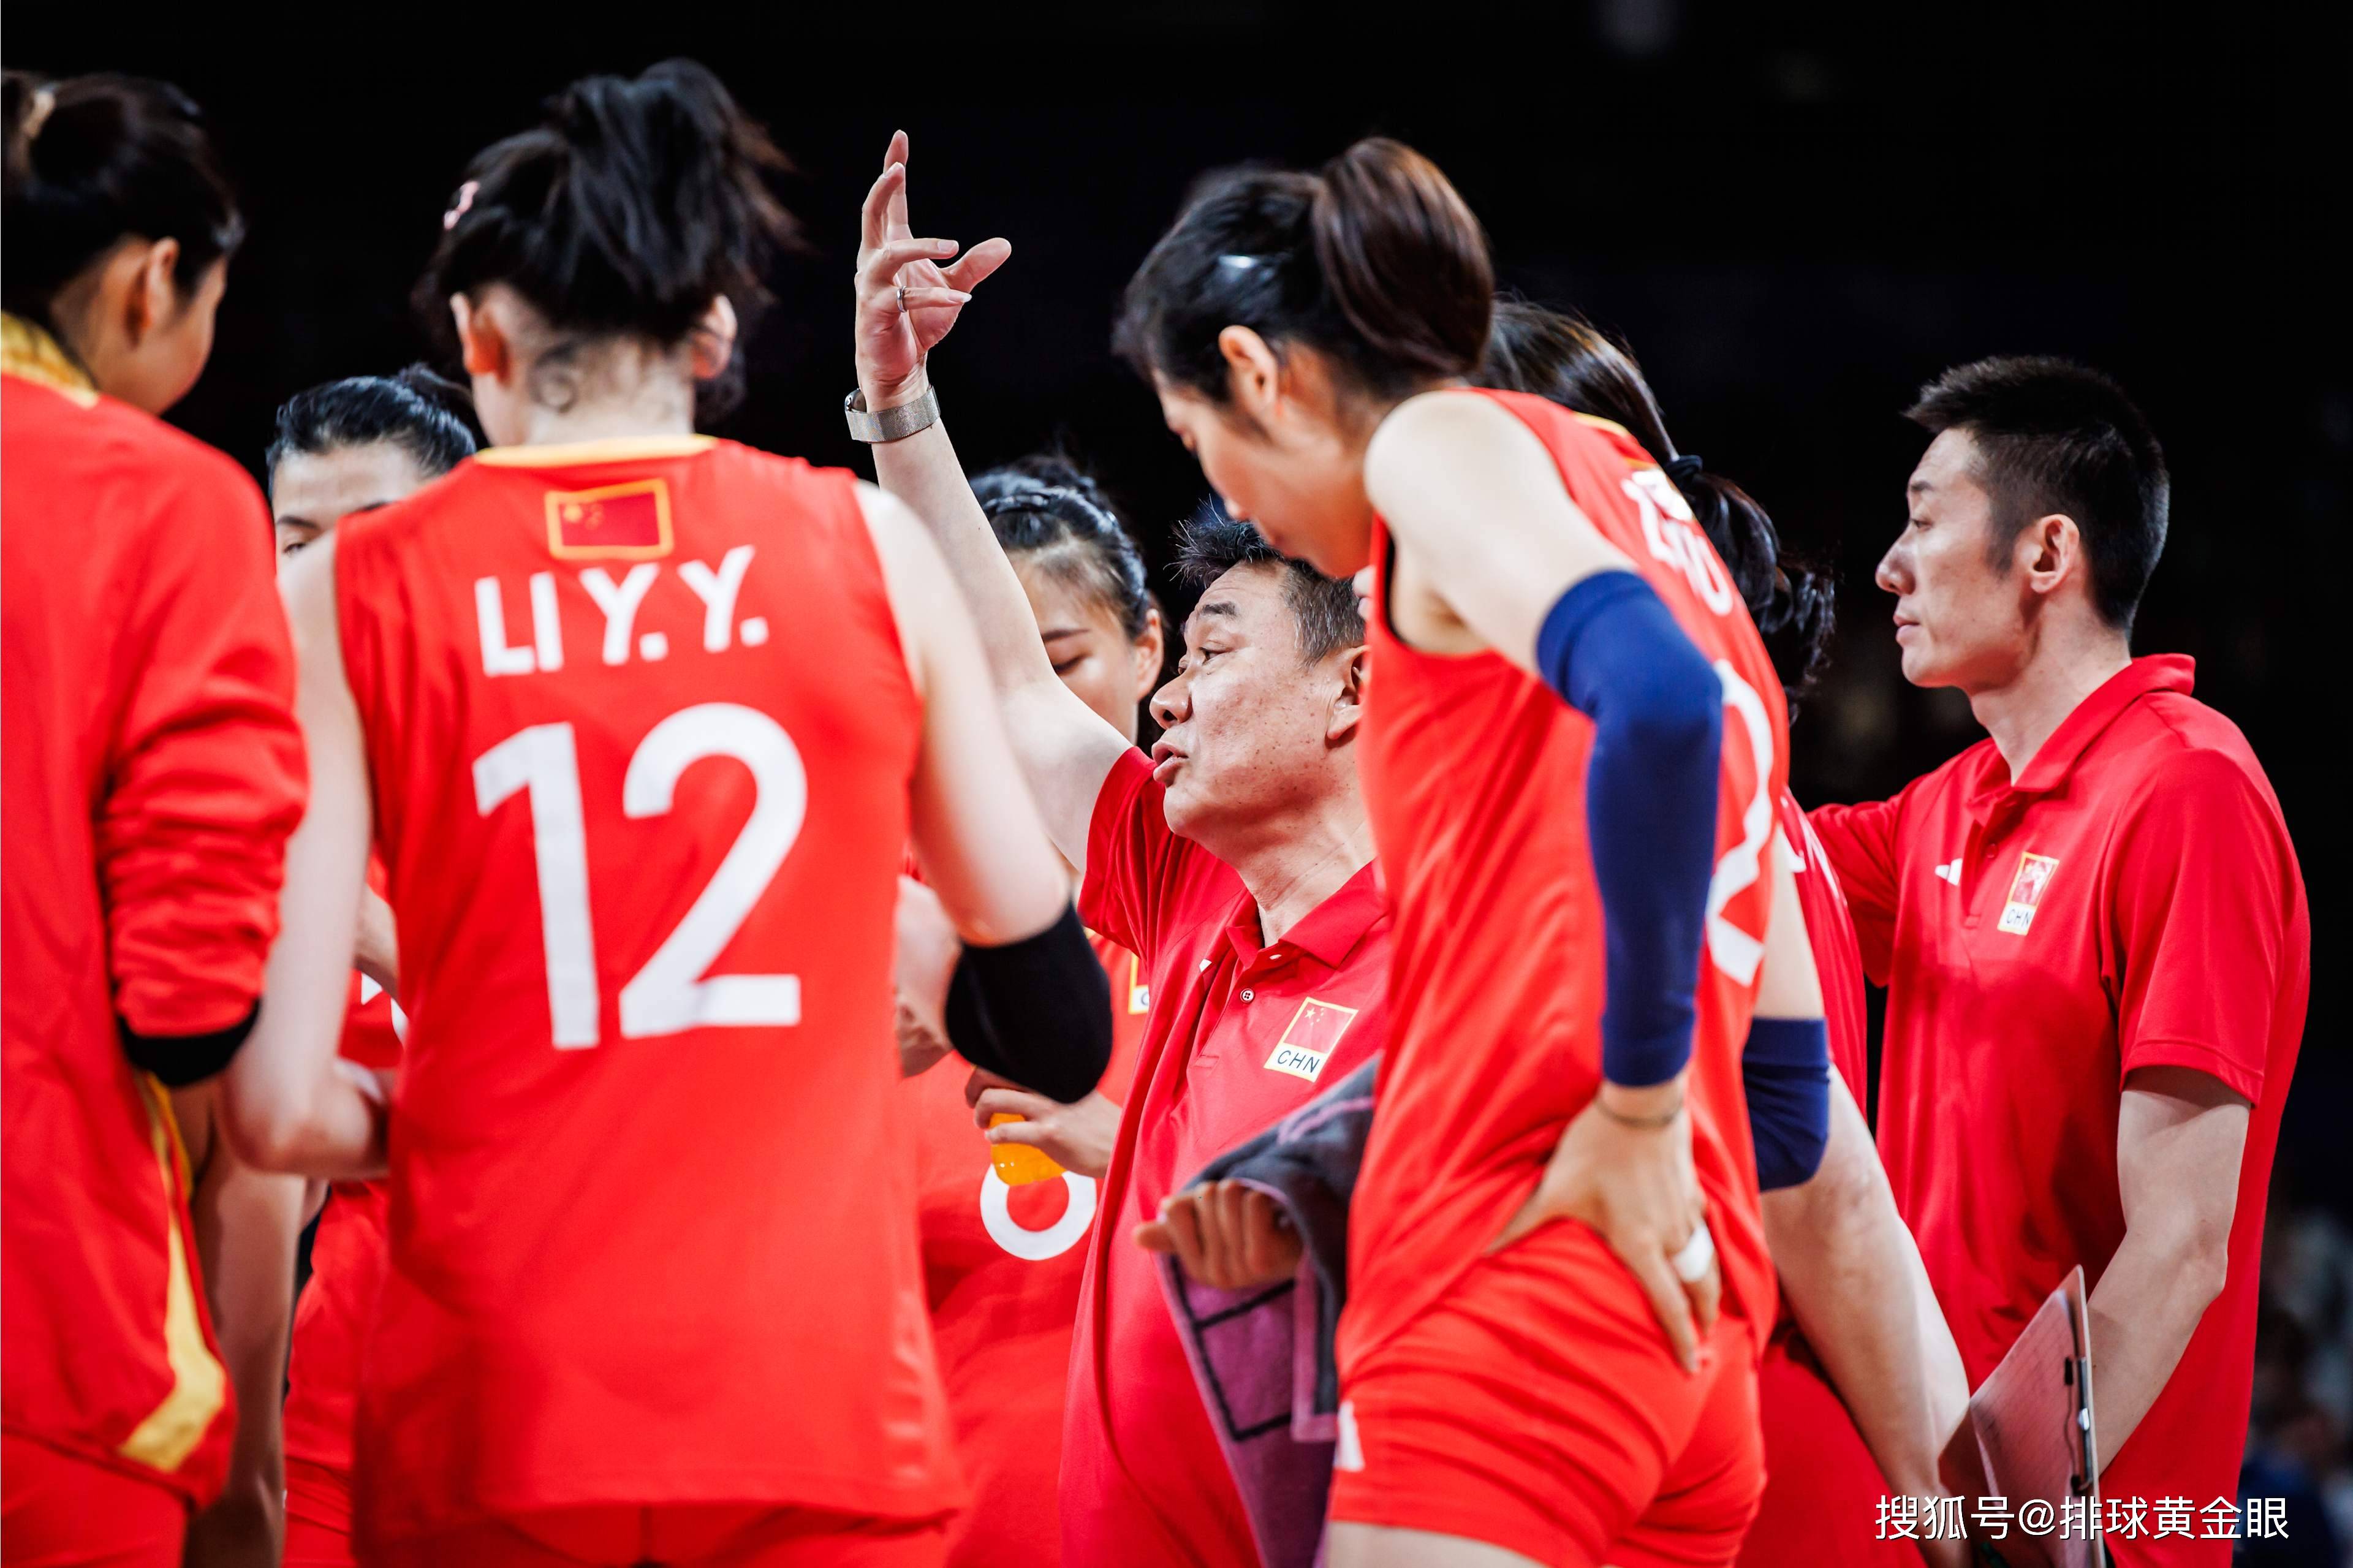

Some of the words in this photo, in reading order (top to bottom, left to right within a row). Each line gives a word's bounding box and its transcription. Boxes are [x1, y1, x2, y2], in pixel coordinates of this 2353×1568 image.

[474, 571, 564, 677] LI
[472, 702, 808, 1050] 12
[2006, 908, 2031, 927] CHN
[1278, 1050, 1320, 1074] CHN
